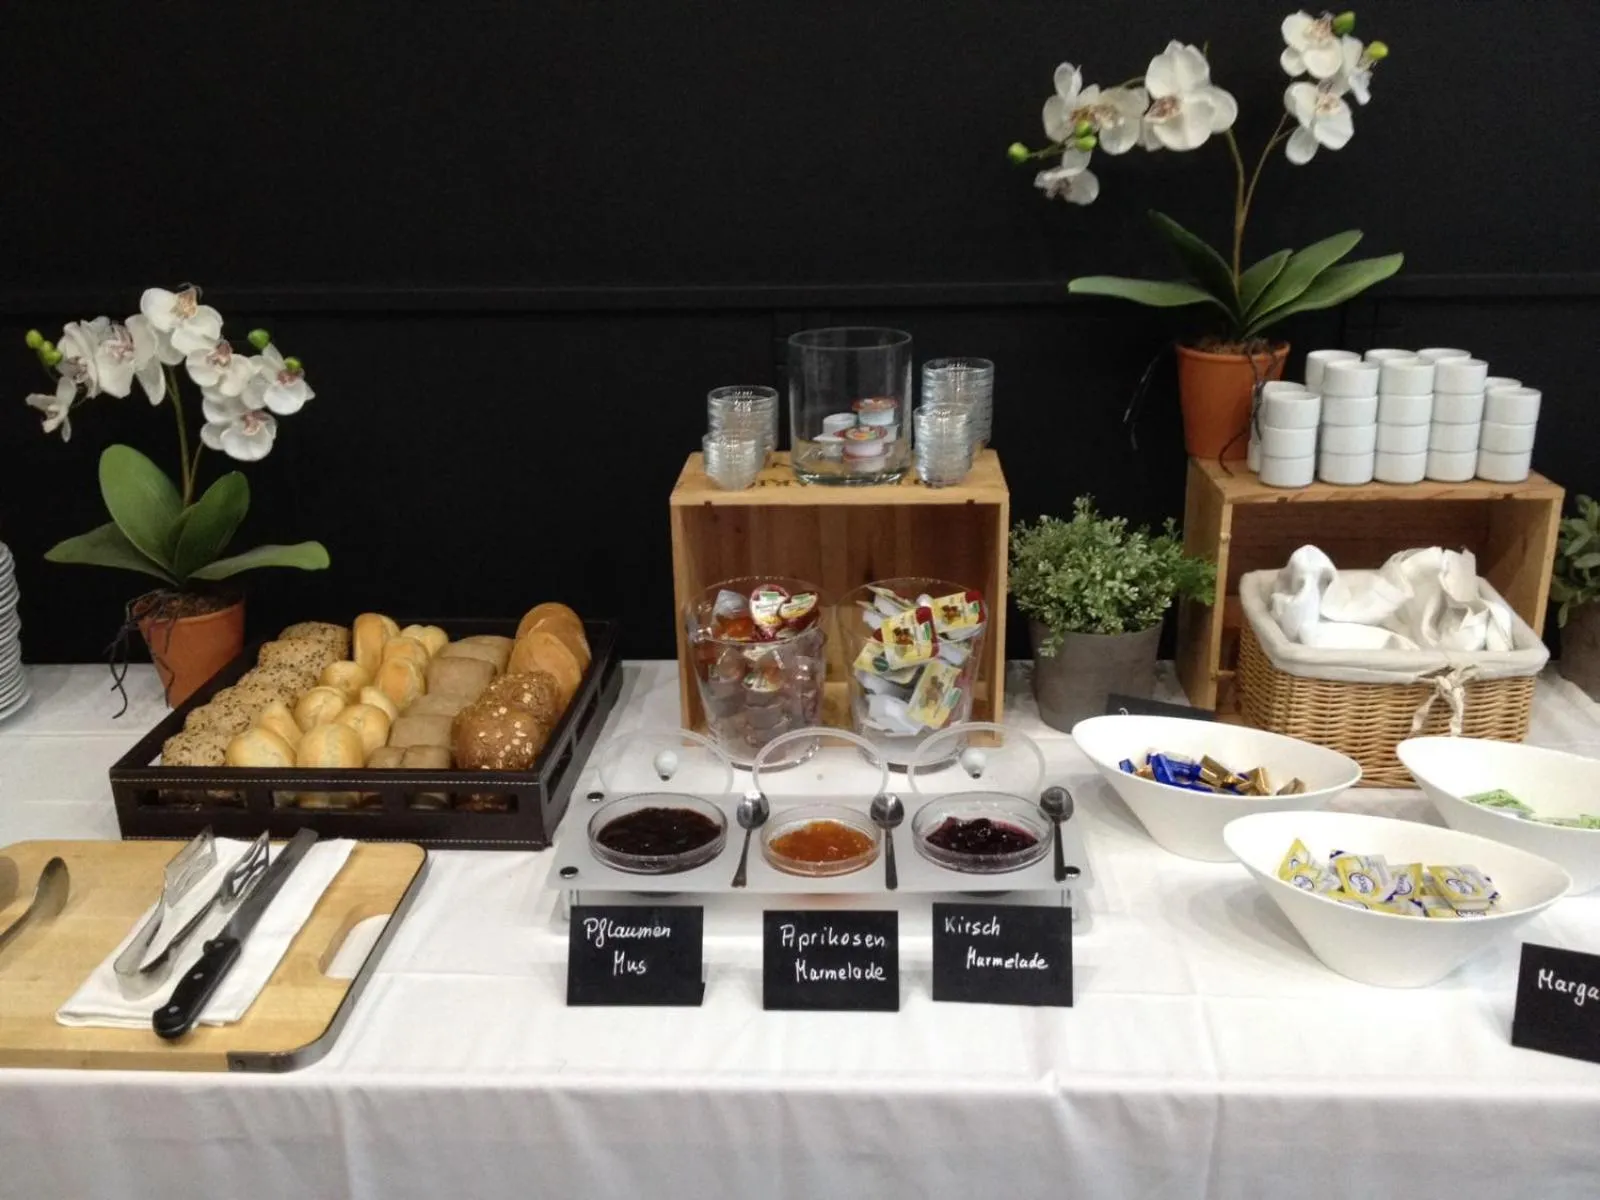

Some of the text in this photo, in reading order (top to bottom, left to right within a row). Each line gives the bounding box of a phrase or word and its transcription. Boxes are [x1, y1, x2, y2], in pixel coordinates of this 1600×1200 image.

[583, 917, 671, 948] Pflaumen
[779, 923, 886, 953] Aprikosen
[944, 915, 1001, 937] Kirsch
[613, 950, 647, 976] Mus
[966, 945, 1049, 970] Marmelade
[794, 958, 887, 983] Marmelade
